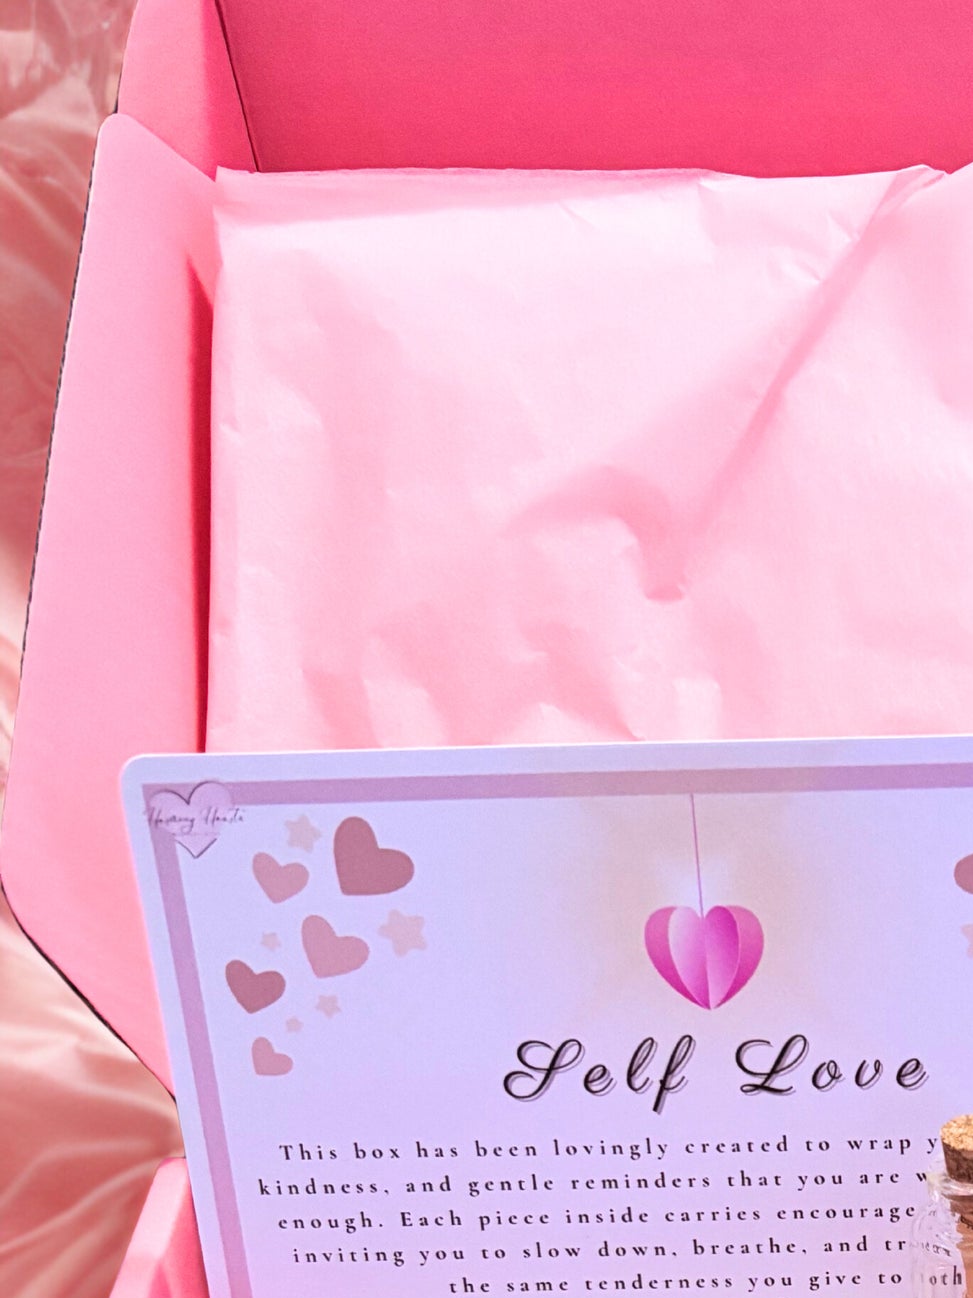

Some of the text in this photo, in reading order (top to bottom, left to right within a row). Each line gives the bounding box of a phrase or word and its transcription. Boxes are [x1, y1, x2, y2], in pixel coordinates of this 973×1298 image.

[502, 1034, 927, 1115] Self Love
[278, 1142, 338, 1161] This
[353, 1141, 400, 1160] box
[415, 1140, 458, 1158] has
[474, 1139, 537, 1158] been
[553, 1137, 668, 1161] lovingly
[684, 1134, 789, 1154] created
[805, 1140, 830, 1152] to
[846, 1138, 911, 1156] wrap
[257, 1177, 389, 1196] kindness,
[405, 1174, 452, 1193] and
[468, 1173, 554, 1198] gentle
[570, 1171, 710, 1190] reminders
[727, 1169, 782, 1187] that
[797, 1174, 843, 1192] you
[859, 1173, 900, 1185] are
[278, 1210, 384, 1235] enough.
[400, 1209, 462, 1227] Each
[478, 1210, 550, 1232] piece
[565, 1206, 649, 1224] inside
[664, 1206, 761, 1223] carries
[293, 1247, 405, 1268] inviting
[418, 1249, 465, 1267] you
[481, 1248, 506, 1260] to
[522, 1241, 581, 1259] slow
[597, 1240, 677, 1257] down,
[692, 1236, 807, 1256] breathe,
[823, 1234, 868, 1253] and
[449, 1276, 490, 1294] the
[506, 1280, 569, 1293] same
[584, 1272, 733, 1291] tenderness
[747, 1276, 793, 1293] you
[808, 1271, 861, 1292] give
[878, 1273, 902, 1285] to
